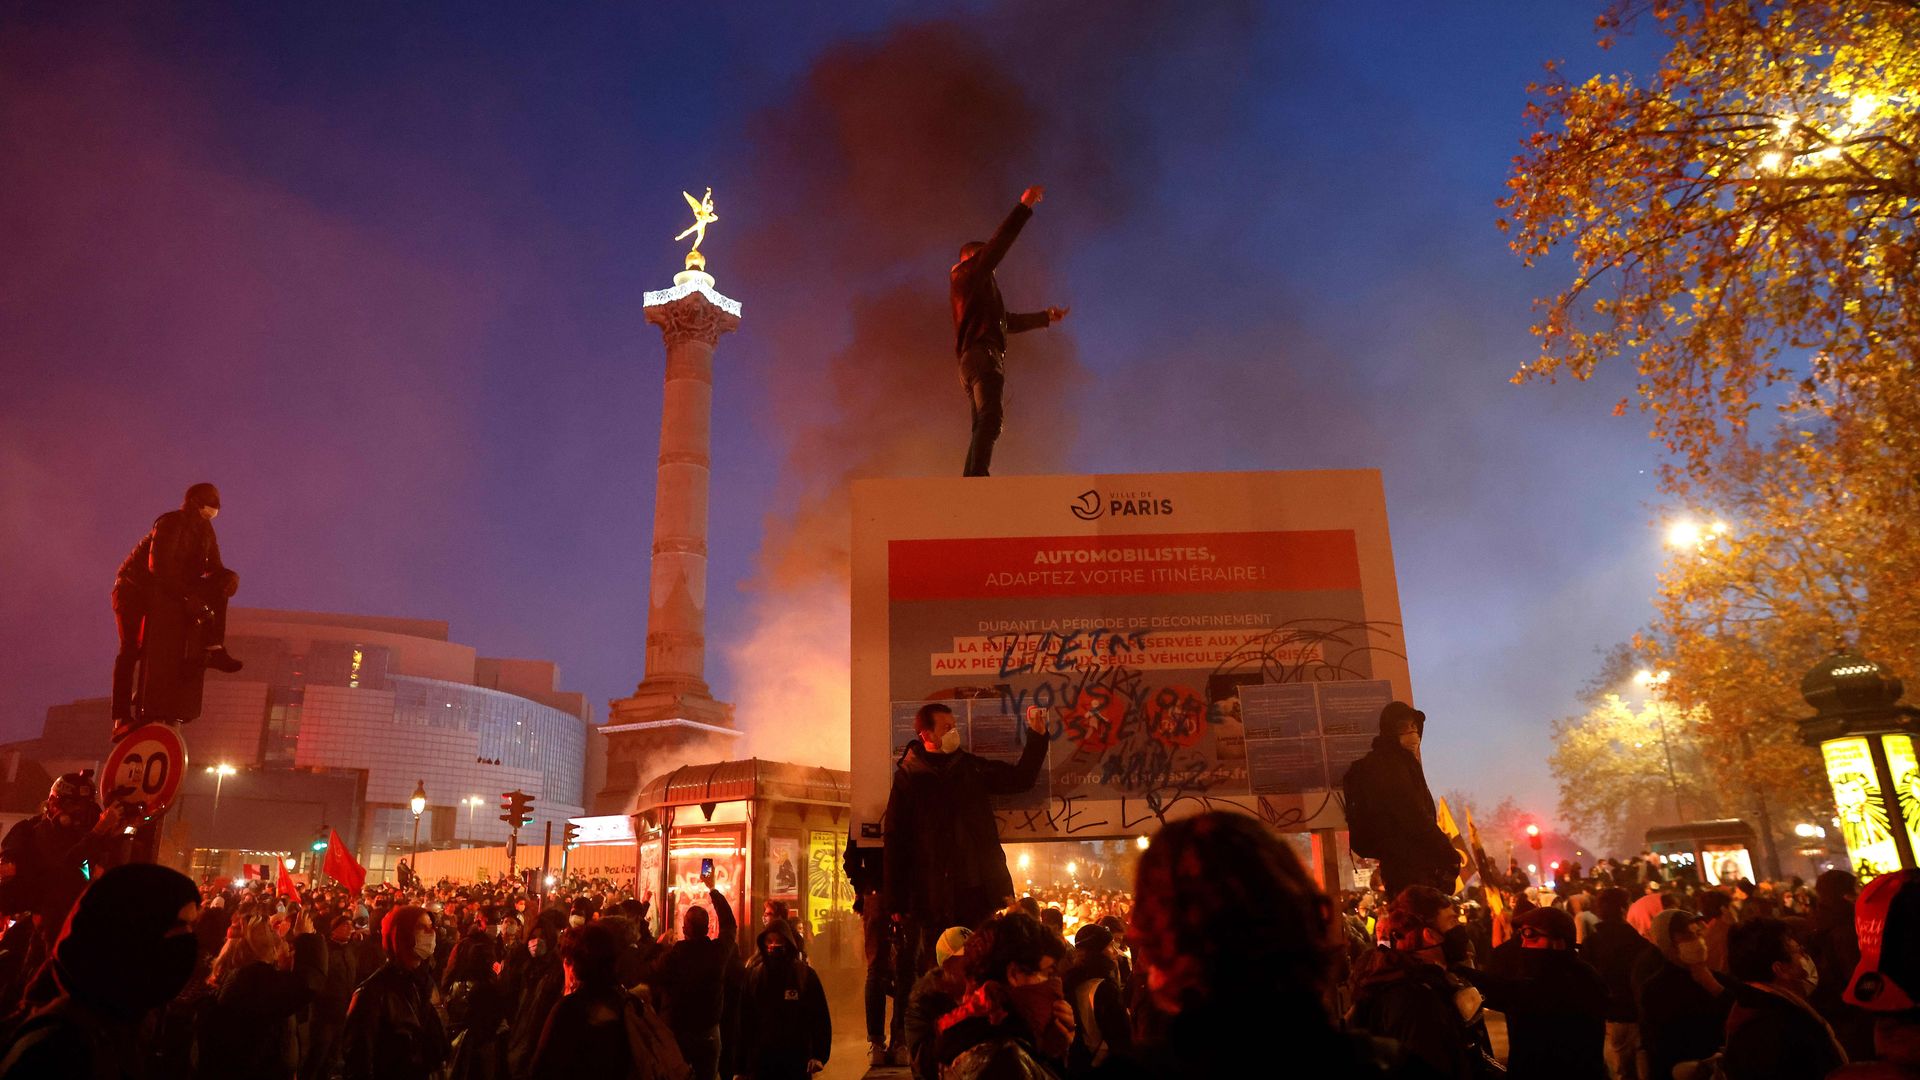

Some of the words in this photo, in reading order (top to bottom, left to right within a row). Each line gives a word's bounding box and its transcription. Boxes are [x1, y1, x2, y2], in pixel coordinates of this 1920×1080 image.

[1110, 499, 1173, 516] PARIS
[1033, 545, 1216, 564] AUTOMOBILISTES,
[984, 570, 1076, 587] ADAPTEZ
[1080, 568, 1143, 585] VOTRE
[978, 620, 1038, 632] DURANT
[1041, 619, 1059, 631] LA
[1062, 616, 1124, 630] PÉRIODE
[1128, 616, 1147, 628] DE
[958, 642, 977, 653] LA
[1207, 635, 1238, 647] AUX
[936, 658, 967, 670] AUX
[1098, 652, 1145, 665] SEULS
[1150, 649, 1233, 664] VÉHICULES
[588, 866, 600, 875] LA
